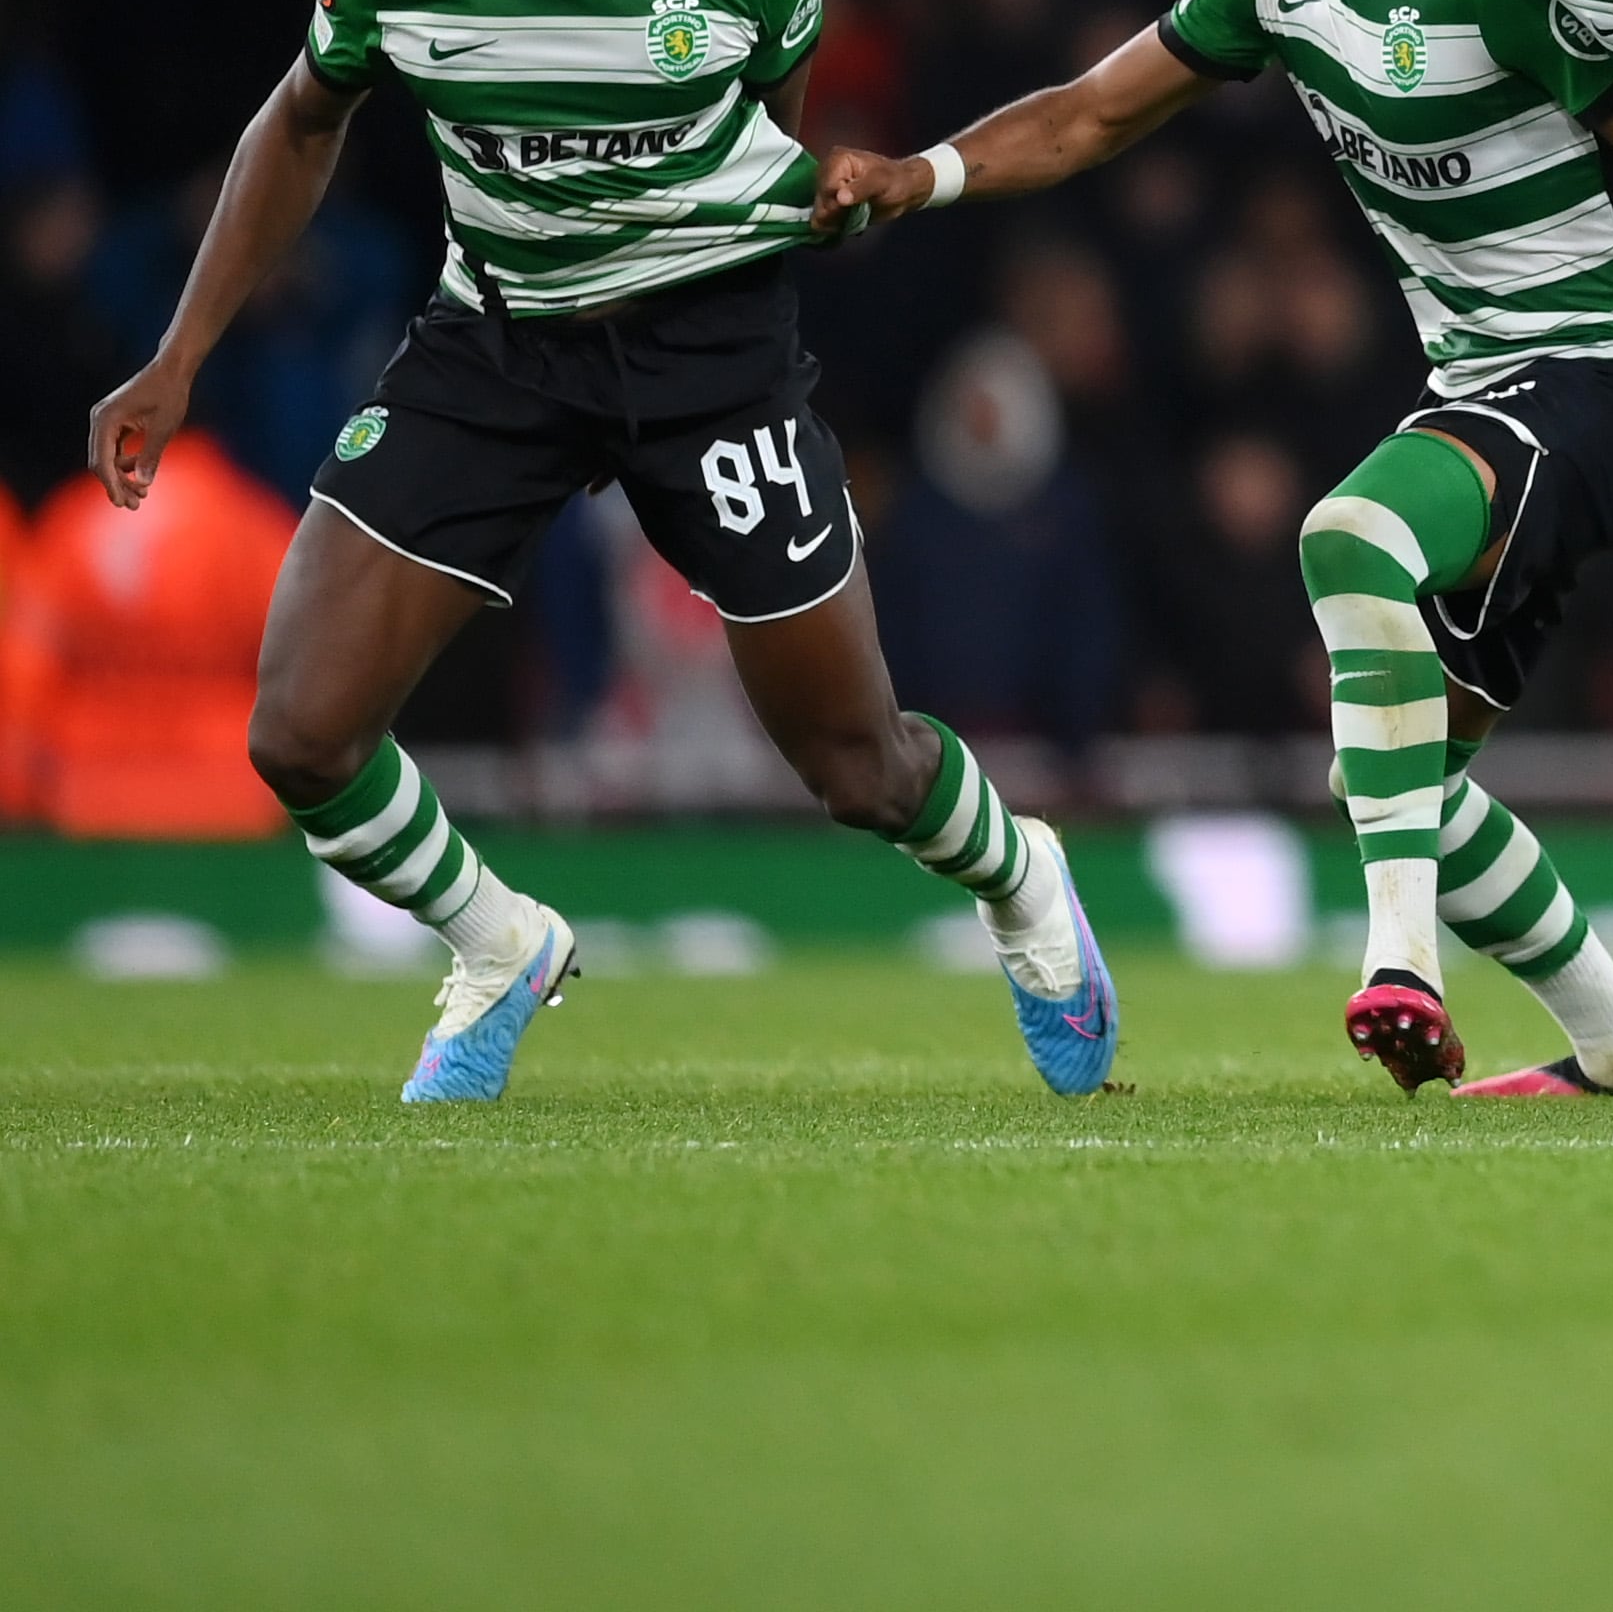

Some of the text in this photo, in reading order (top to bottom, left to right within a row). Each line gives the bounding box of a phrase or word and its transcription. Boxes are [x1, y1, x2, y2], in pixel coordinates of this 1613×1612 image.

[1388, 5, 1420, 24] SCP
[520, 119, 698, 168] BETANO
[1340, 124, 1471, 187] BETANO
[700, 417, 813, 535] 84
